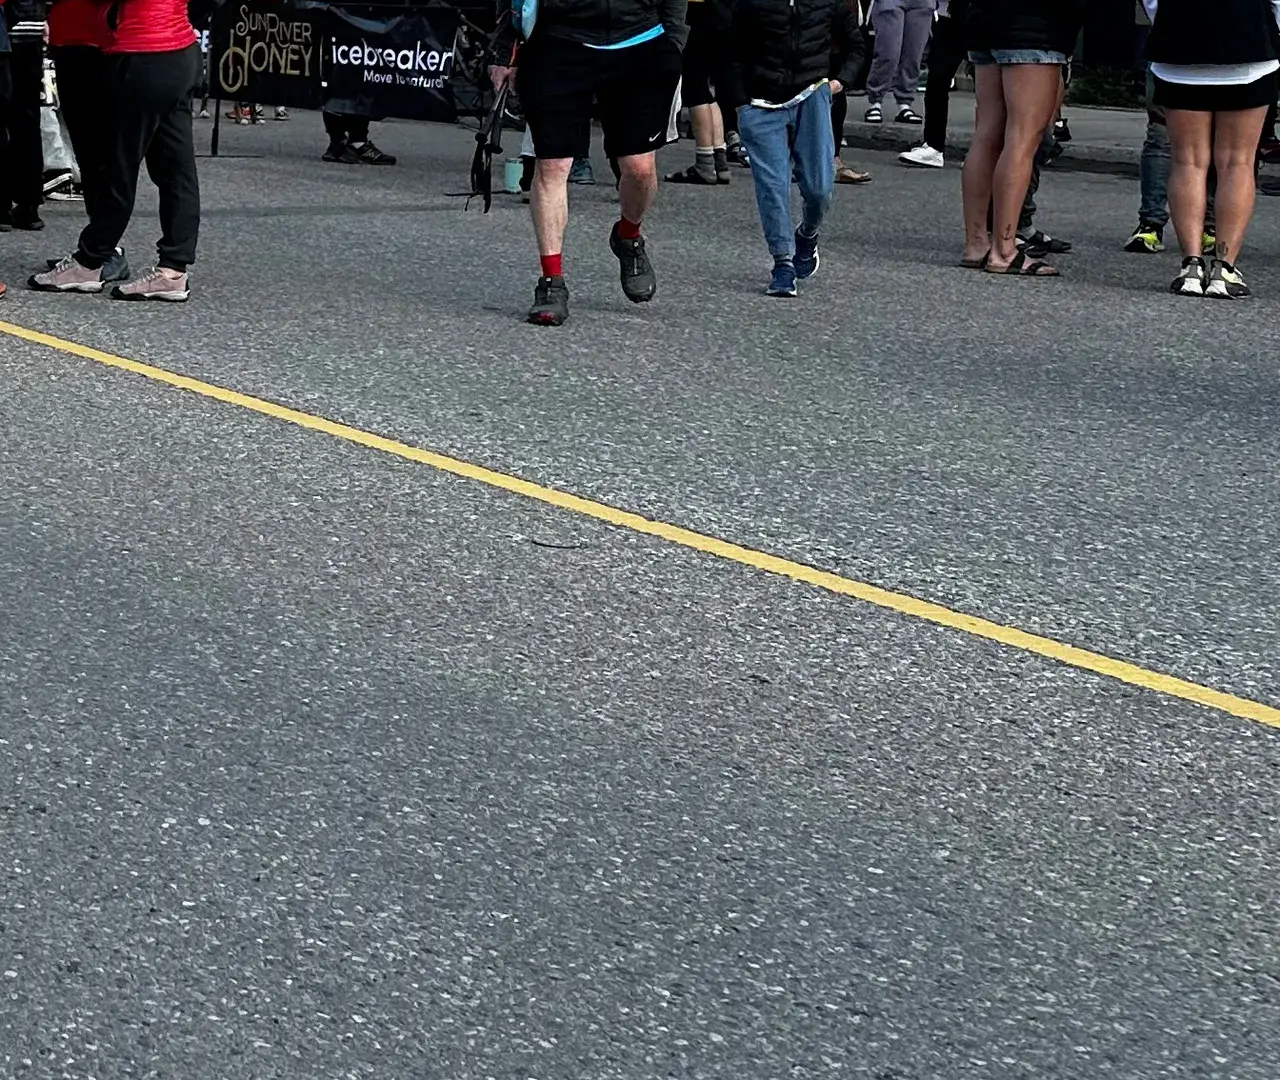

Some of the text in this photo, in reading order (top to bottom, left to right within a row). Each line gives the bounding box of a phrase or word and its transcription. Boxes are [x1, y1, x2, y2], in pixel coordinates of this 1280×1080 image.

[219, 29, 313, 93] HONEY
[331, 36, 454, 72] icebreaker
[363, 69, 393, 84] Move
